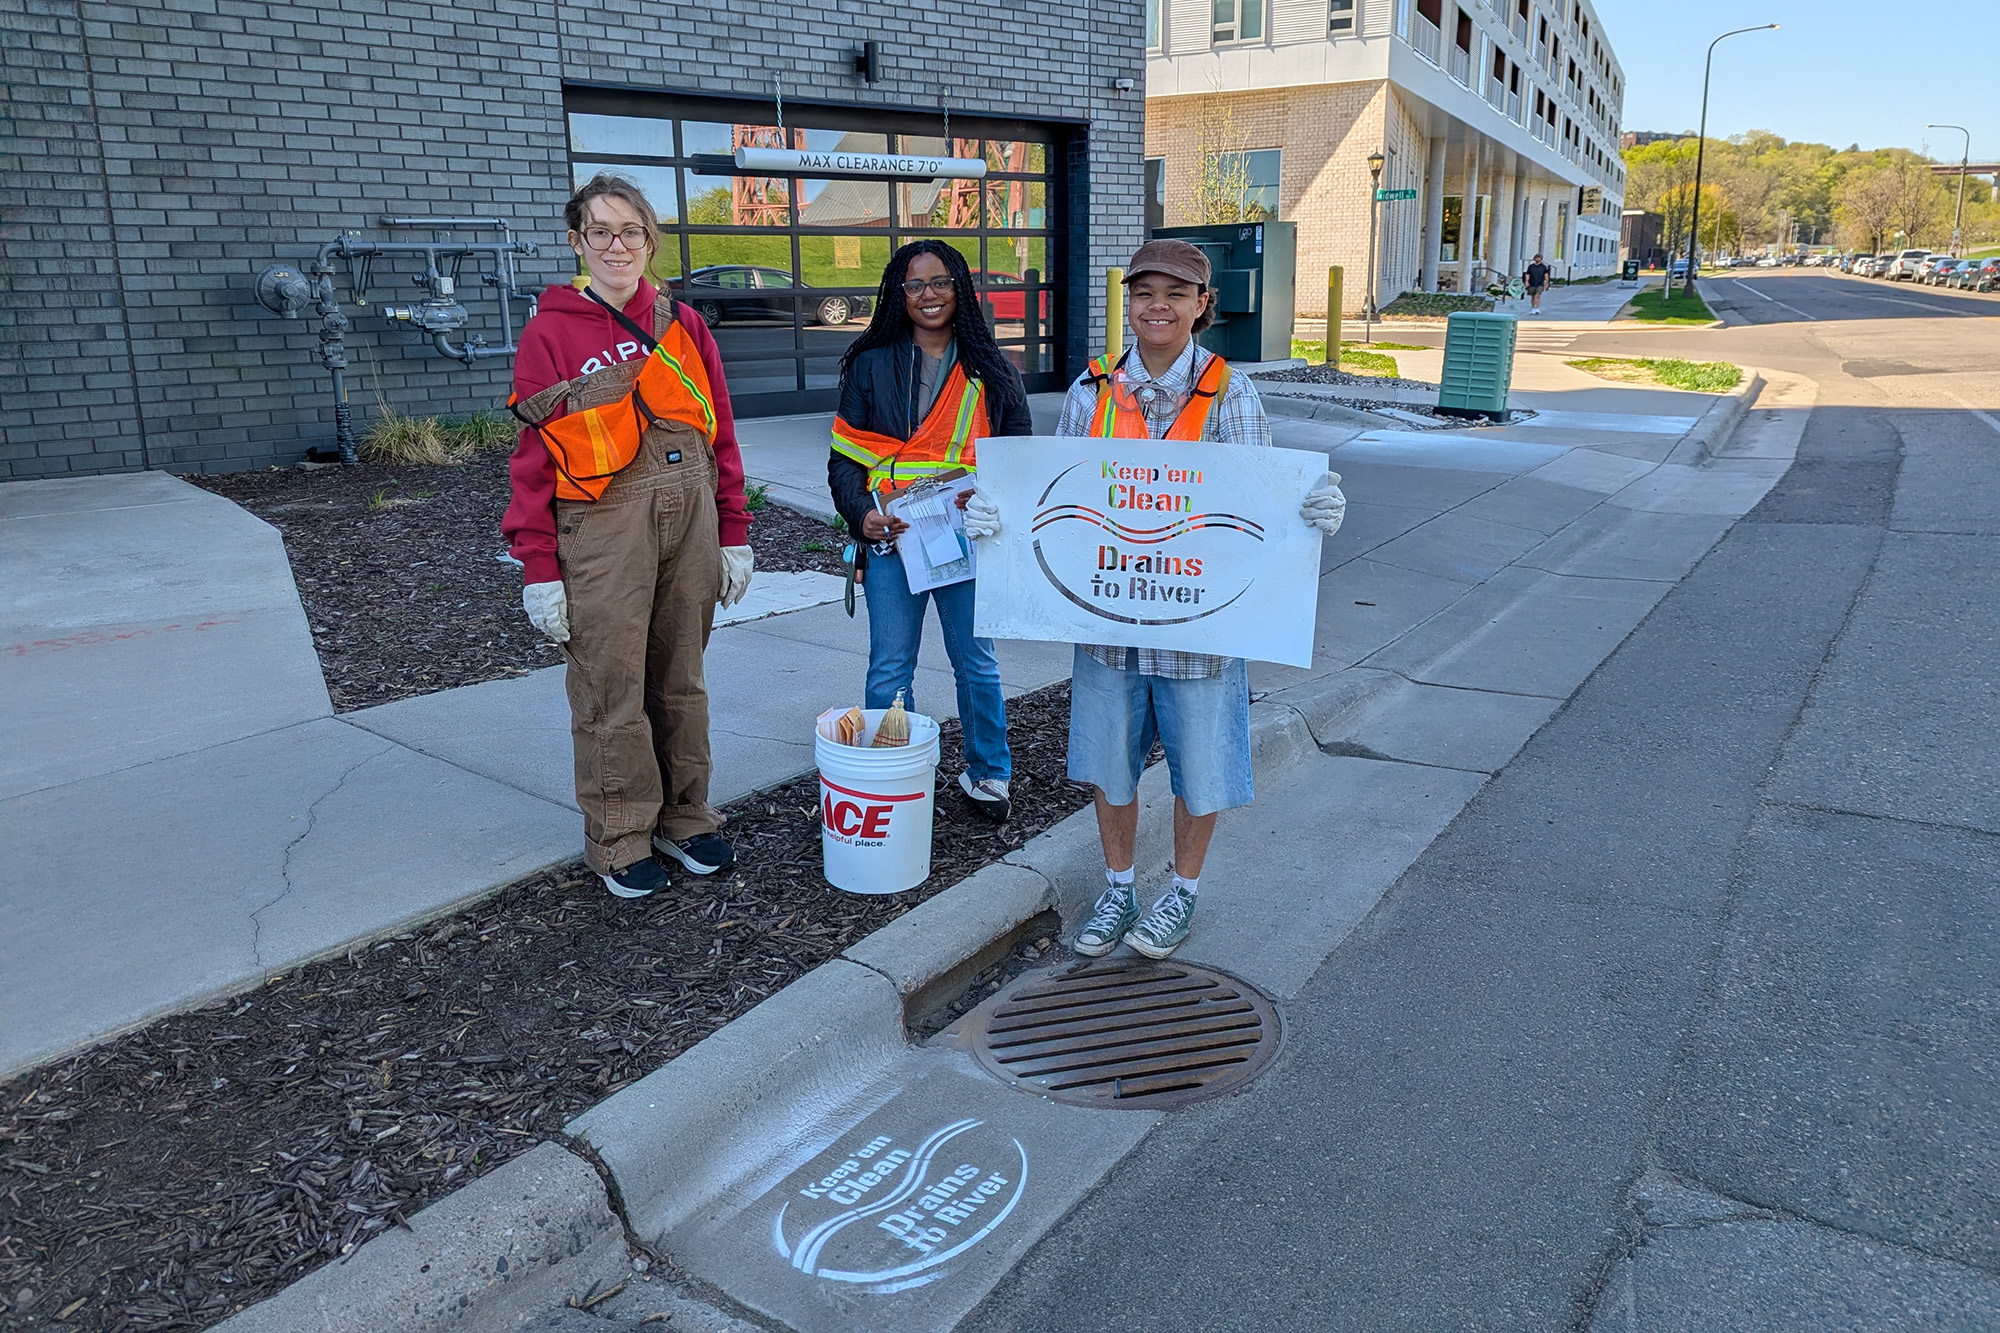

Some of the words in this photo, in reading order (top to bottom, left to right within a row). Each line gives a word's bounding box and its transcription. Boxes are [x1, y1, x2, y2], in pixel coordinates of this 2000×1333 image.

[798, 153, 831, 168] MAX
[836, 155, 914, 172] CLEARANCE
[1101, 460, 1159, 484] Keep
[1163, 464, 1203, 484] 'em
[1108, 484, 1191, 512] Clean
[1098, 545, 1203, 576] Drains
[1090, 573, 1120, 598] to
[1128, 577, 1205, 604] River
[821, 789, 894, 839] ACE
[855, 839, 886, 847] place.
[799, 1160, 860, 1199] Keep
[828, 1149, 912, 1205] Clean
[877, 1163, 980, 1237] Drains
[934, 1171, 1008, 1226] River
